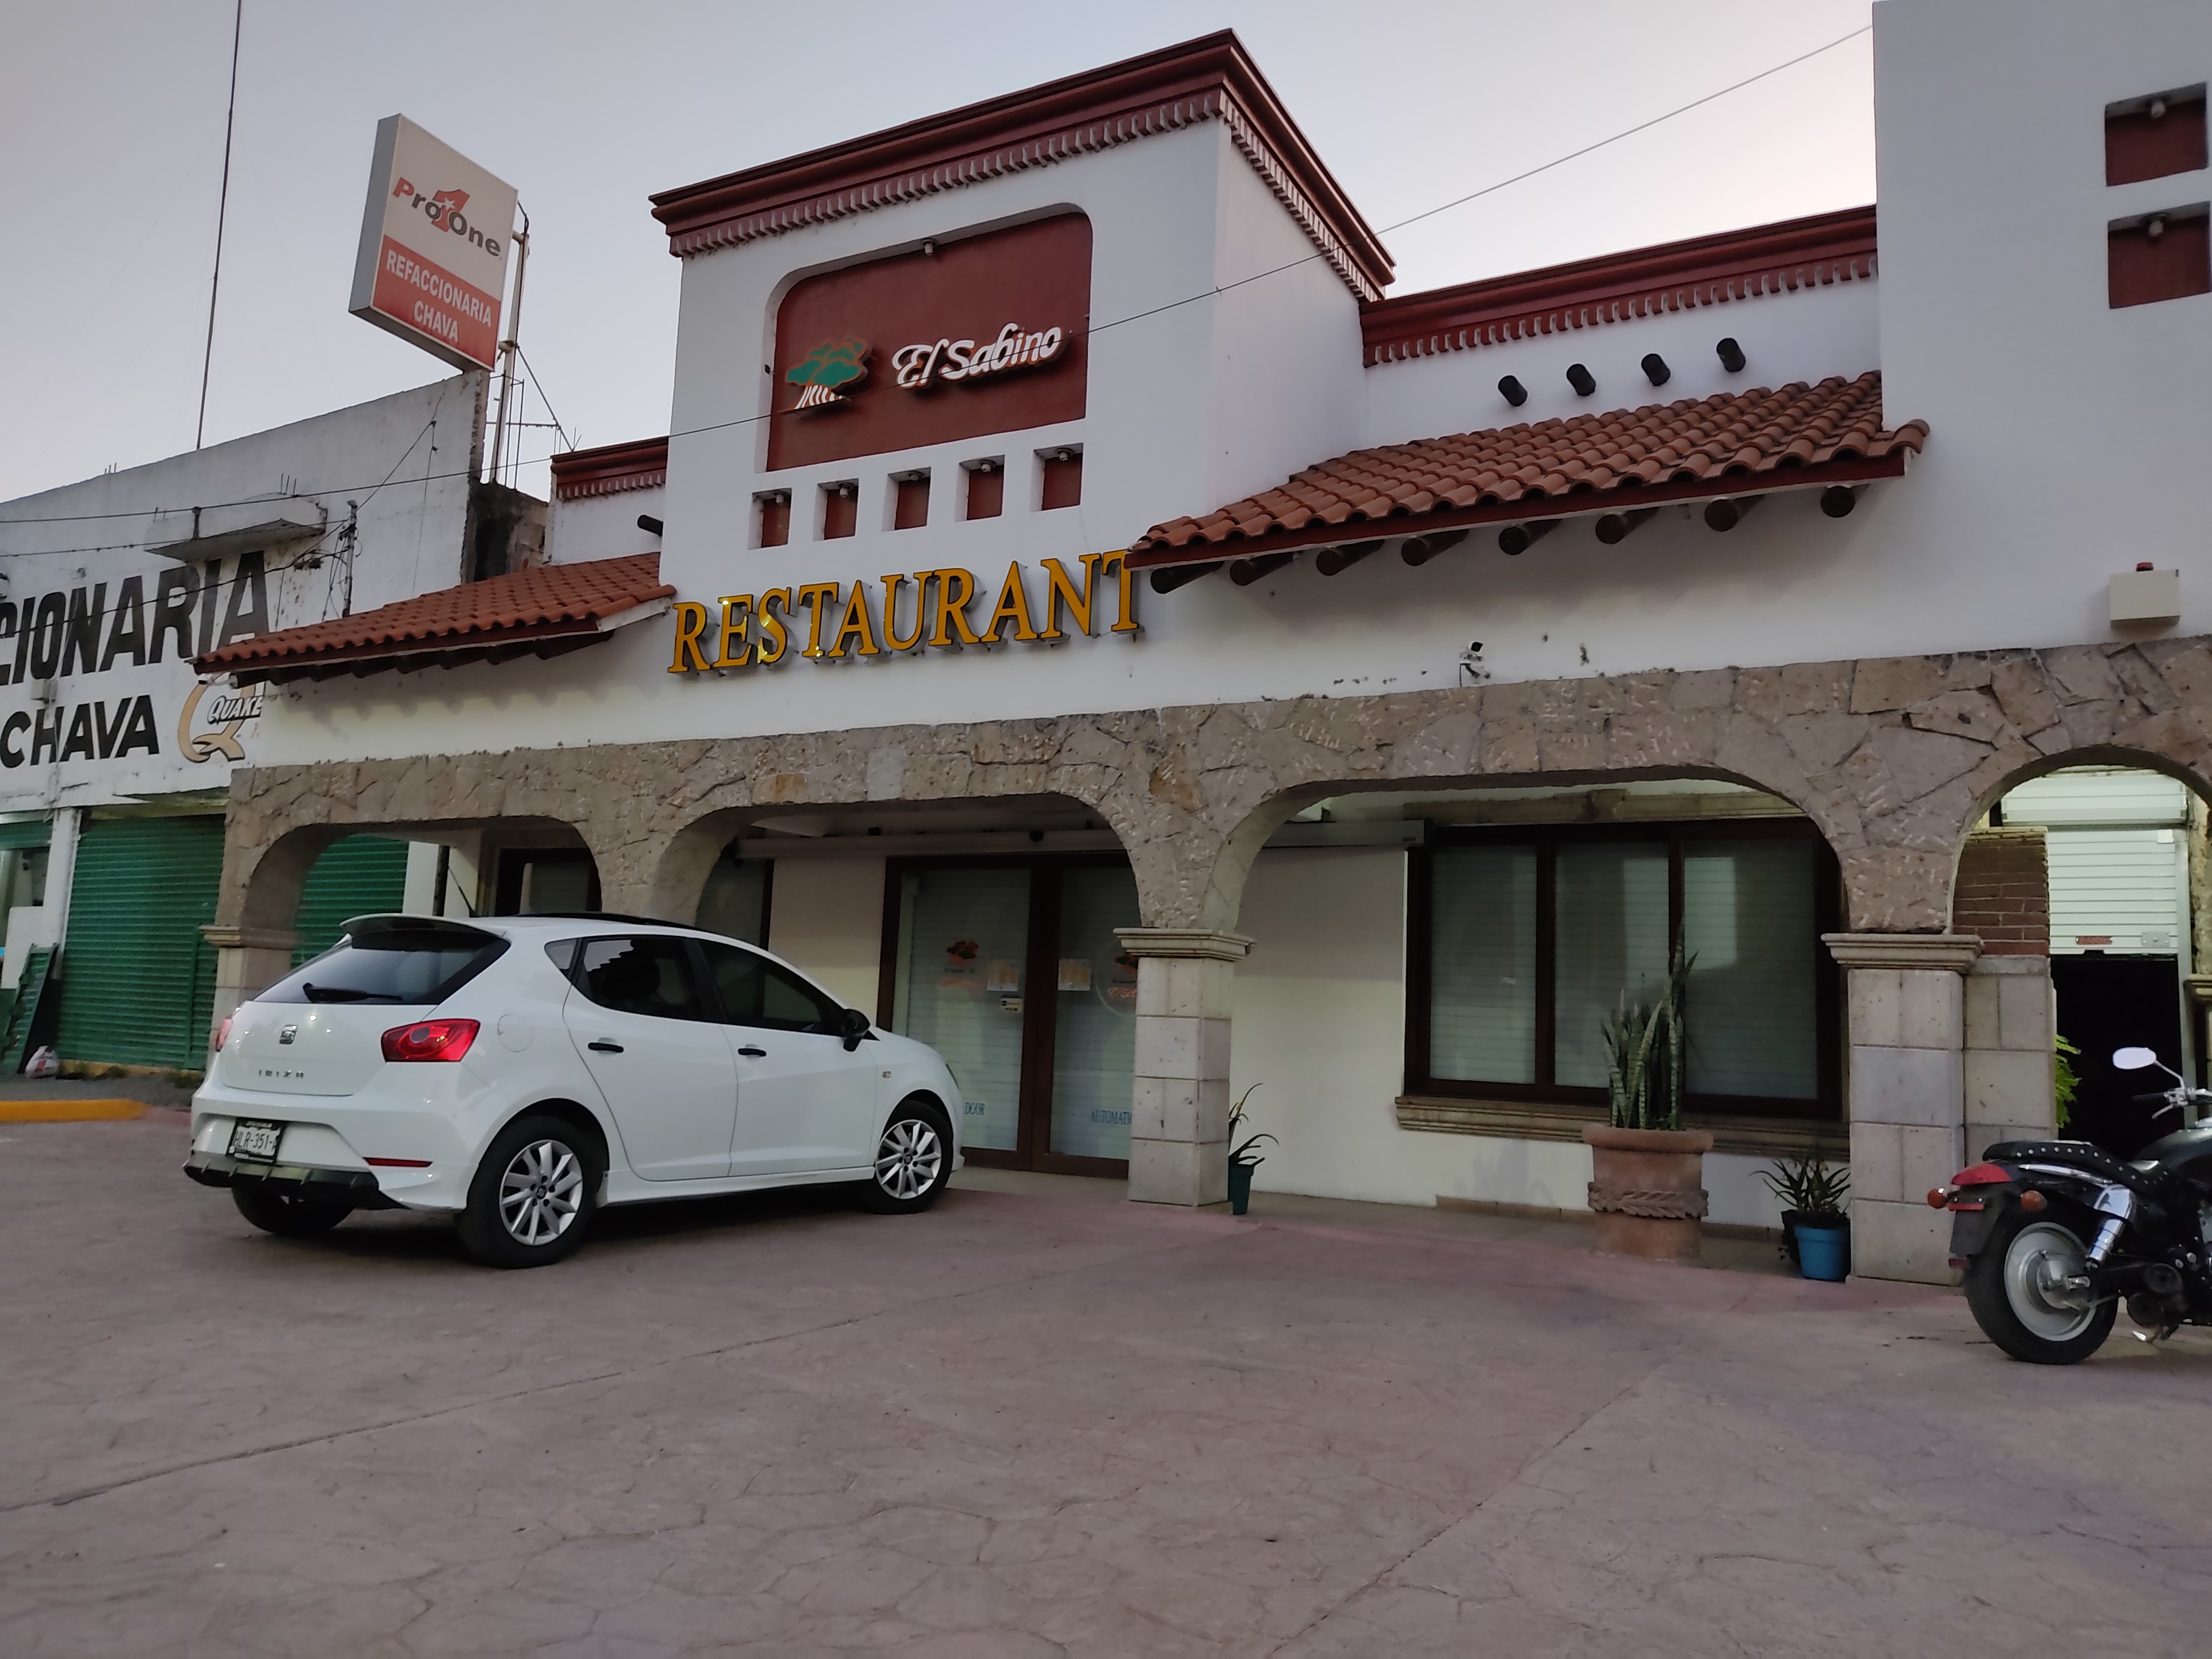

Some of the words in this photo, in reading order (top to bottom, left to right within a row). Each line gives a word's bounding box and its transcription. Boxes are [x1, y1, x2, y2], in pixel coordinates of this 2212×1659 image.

[386, 249, 492, 327] REFACCIONARIA
[414, 300, 459, 342] CHAVA
[892, 338, 948, 388] El
[940, 323, 1062, 381] Sabino
[667, 549, 1139, 674] RESTAURANT
[0, 695, 160, 768] CHAVA
[259, 1069, 304, 1079] IBIZA
[965, 1102, 985, 1116] DOOR
[1091, 1110, 1132, 1125] AUTOMATI
